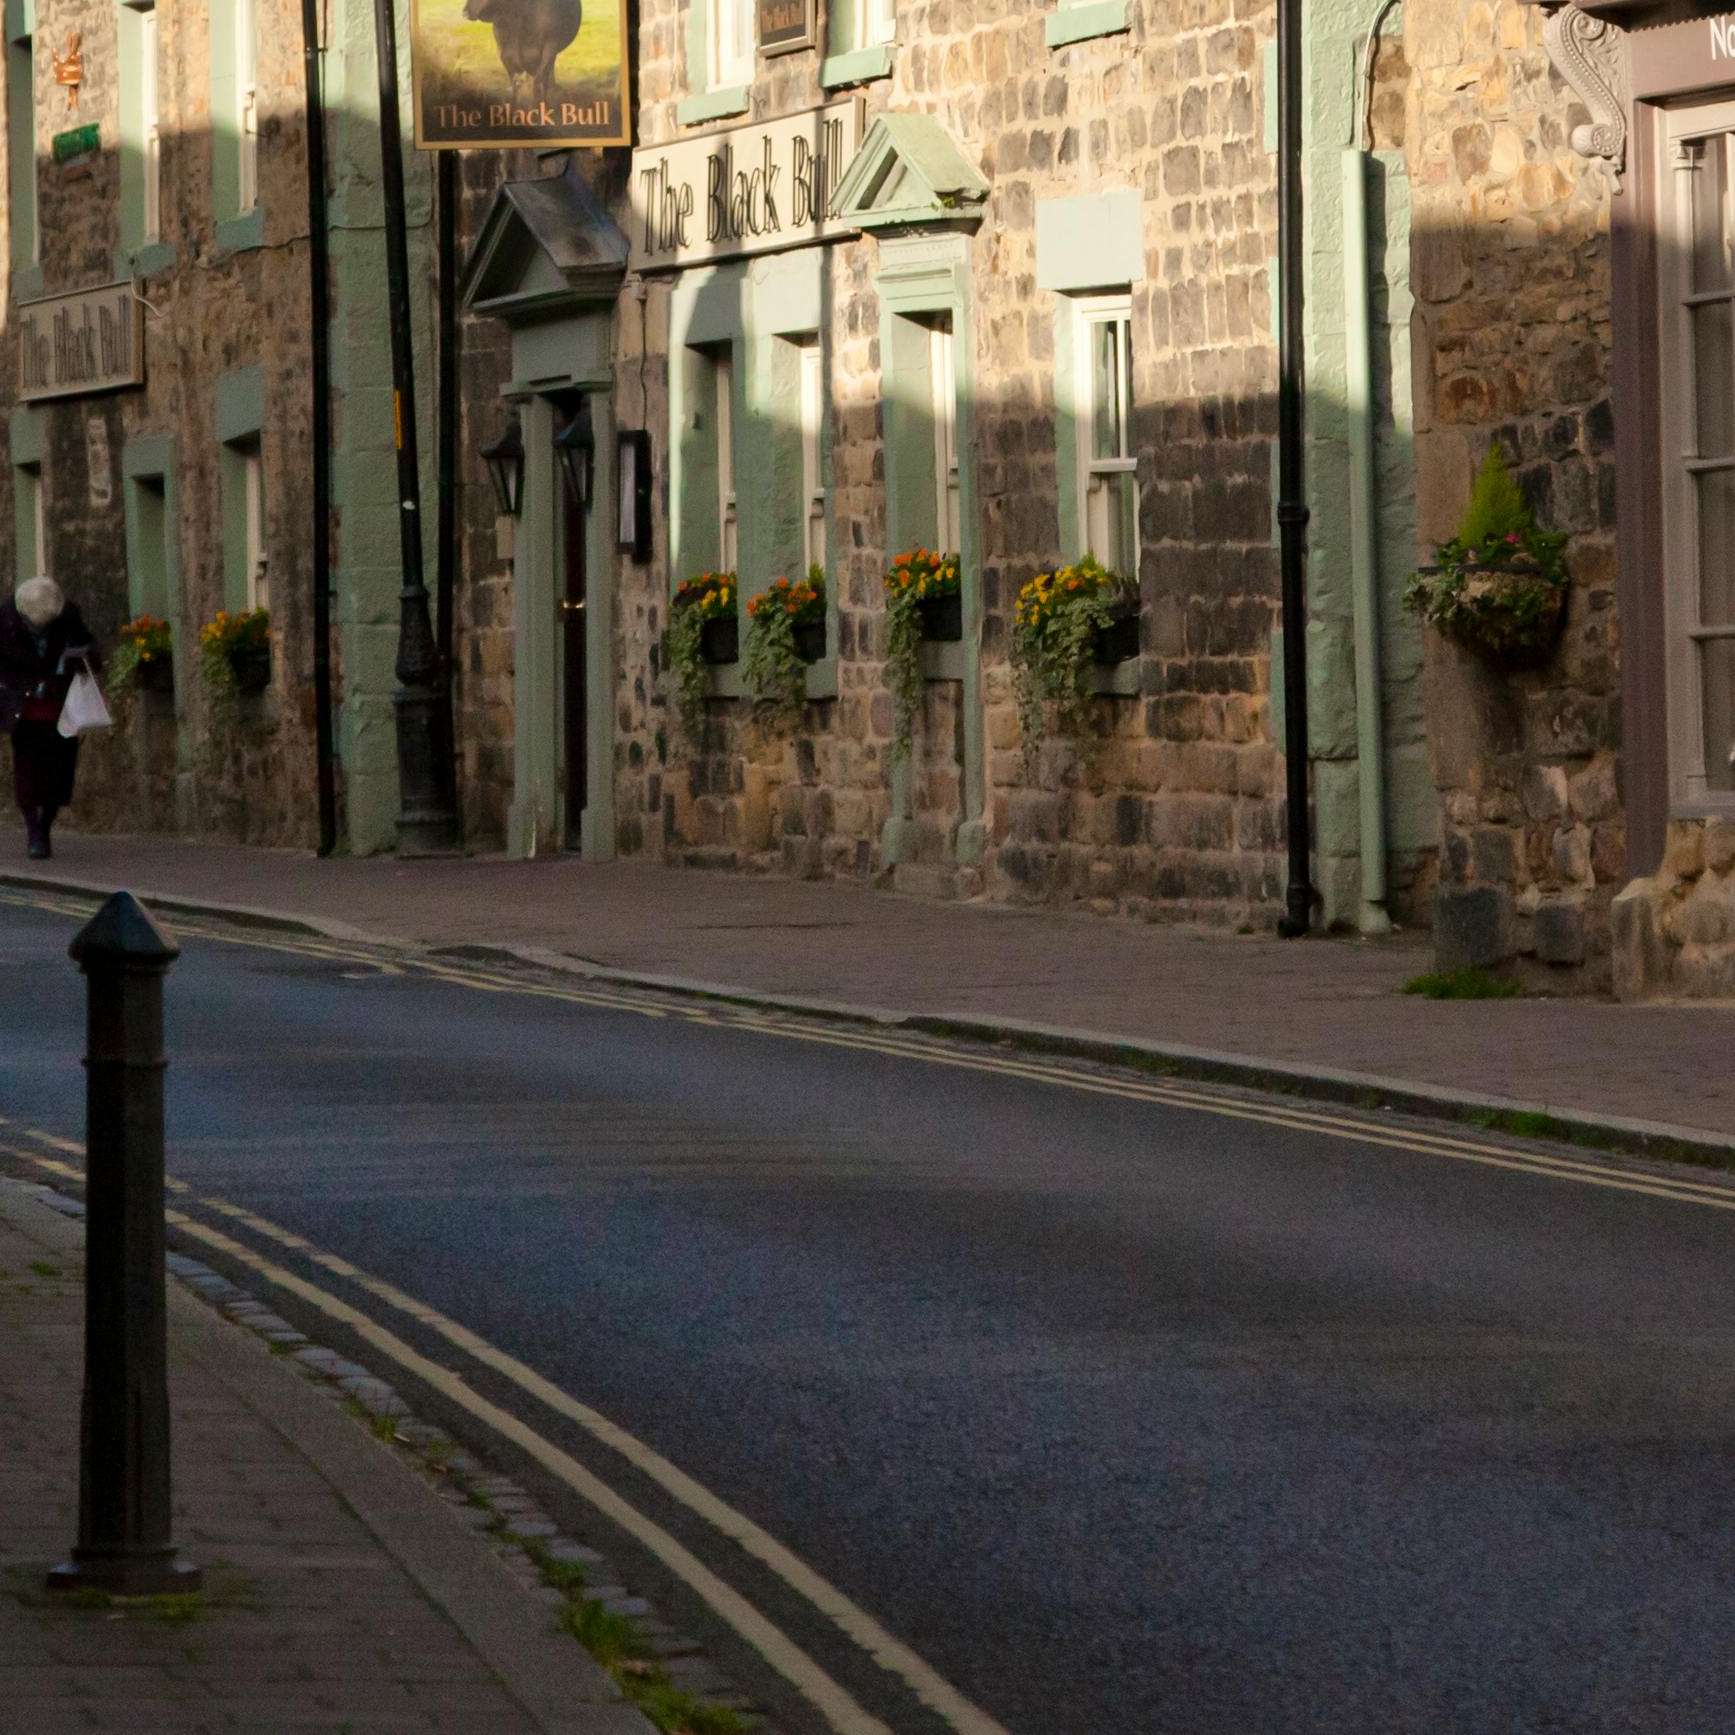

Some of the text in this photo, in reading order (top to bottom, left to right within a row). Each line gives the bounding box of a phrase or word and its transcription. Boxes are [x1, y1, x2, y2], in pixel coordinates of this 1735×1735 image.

[434, 100, 611, 128] The Black Bull
[640, 117, 844, 256] The Black Bull
